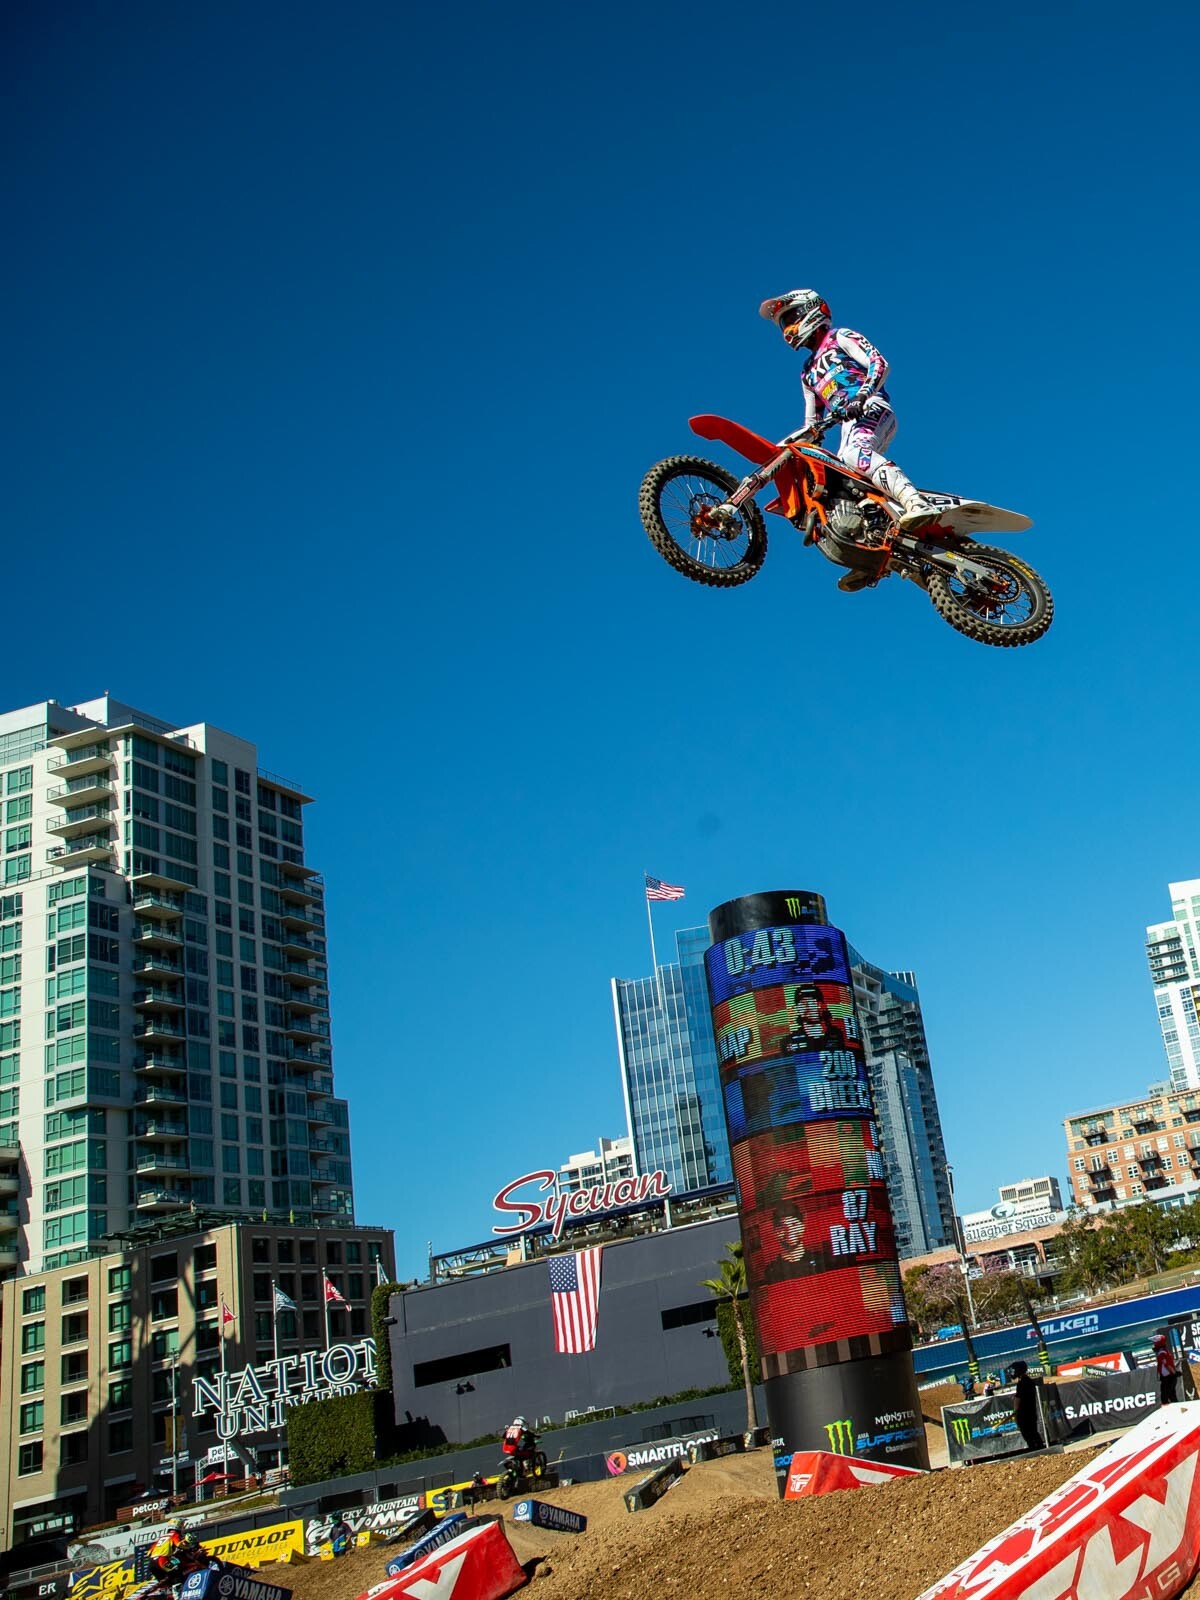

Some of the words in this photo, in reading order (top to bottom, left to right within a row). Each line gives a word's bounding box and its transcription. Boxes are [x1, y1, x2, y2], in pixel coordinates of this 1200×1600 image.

[492, 1169, 673, 1238] Sycuan
[829, 1221, 879, 1257] RAY
[965, 1222, 1012, 1241] allagher
[1014, 1213, 1057, 1231] Square
[191, 1337, 378, 1417] NATION
[1079, 1400, 1109, 1417] AIR
[1108, 1391, 1157, 1412] FORCE
[132, 1500, 159, 1517] petco
[365, 1495, 419, 1516] MOUNTAIN
[549, 1506, 581, 1528] YAMAHA
[213, 1528, 296, 1557] DUNLOP
[234, 1577, 283, 1600] YAMAHA
